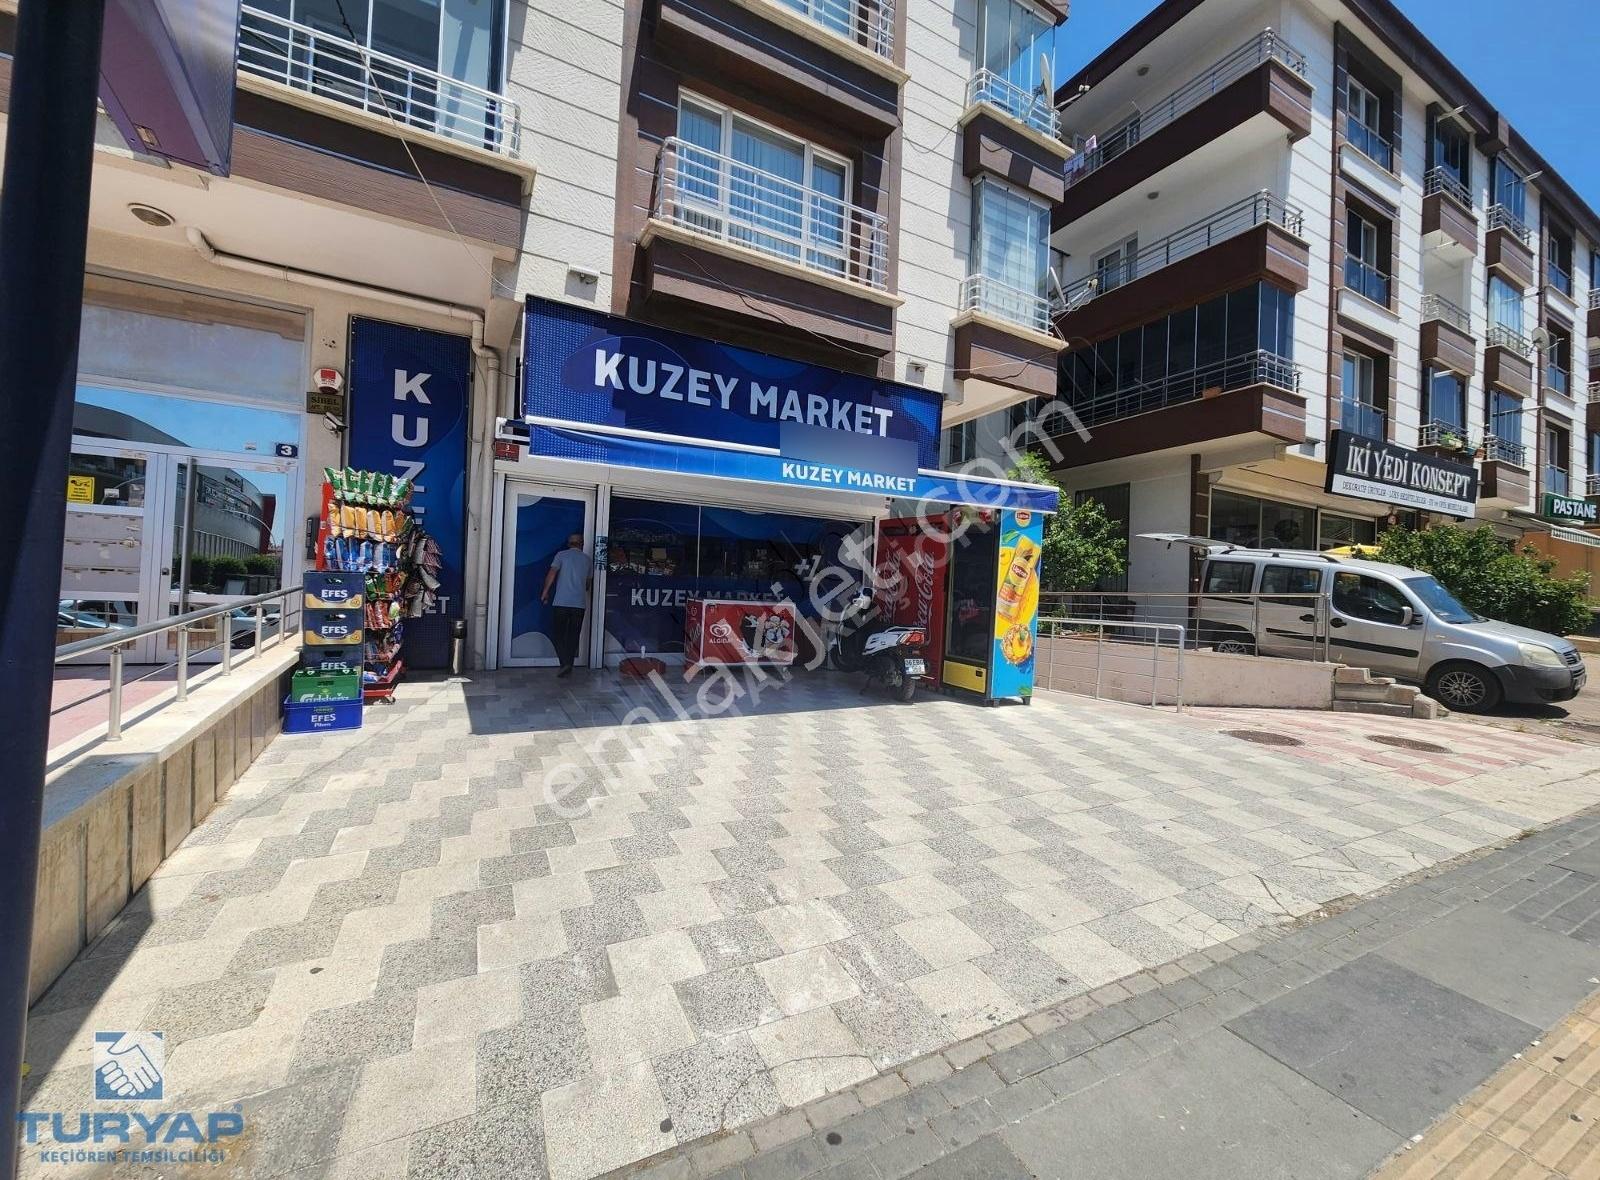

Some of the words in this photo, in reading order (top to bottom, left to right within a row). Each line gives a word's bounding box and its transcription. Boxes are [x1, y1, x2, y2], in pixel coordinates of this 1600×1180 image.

[594, 349, 739, 410] KUZEY
[749, 381, 893, 438] MARKET
[280, 445, 292, 456] 3
[1345, 437, 1372, 477] İKİ
[1410, 461, 1471, 498] KONSEPT
[782, 462, 849, 485] KUZEY
[847, 470, 917, 492] MARKET
[1553, 498, 1597, 519] PASTANE
[321, 589, 348, 598] EFES
[631, 588, 700, 607] KUZEY
[321, 625, 348, 634] EFES
[321, 662, 347, 670] EFES
[311, 713, 336, 722] EFES
